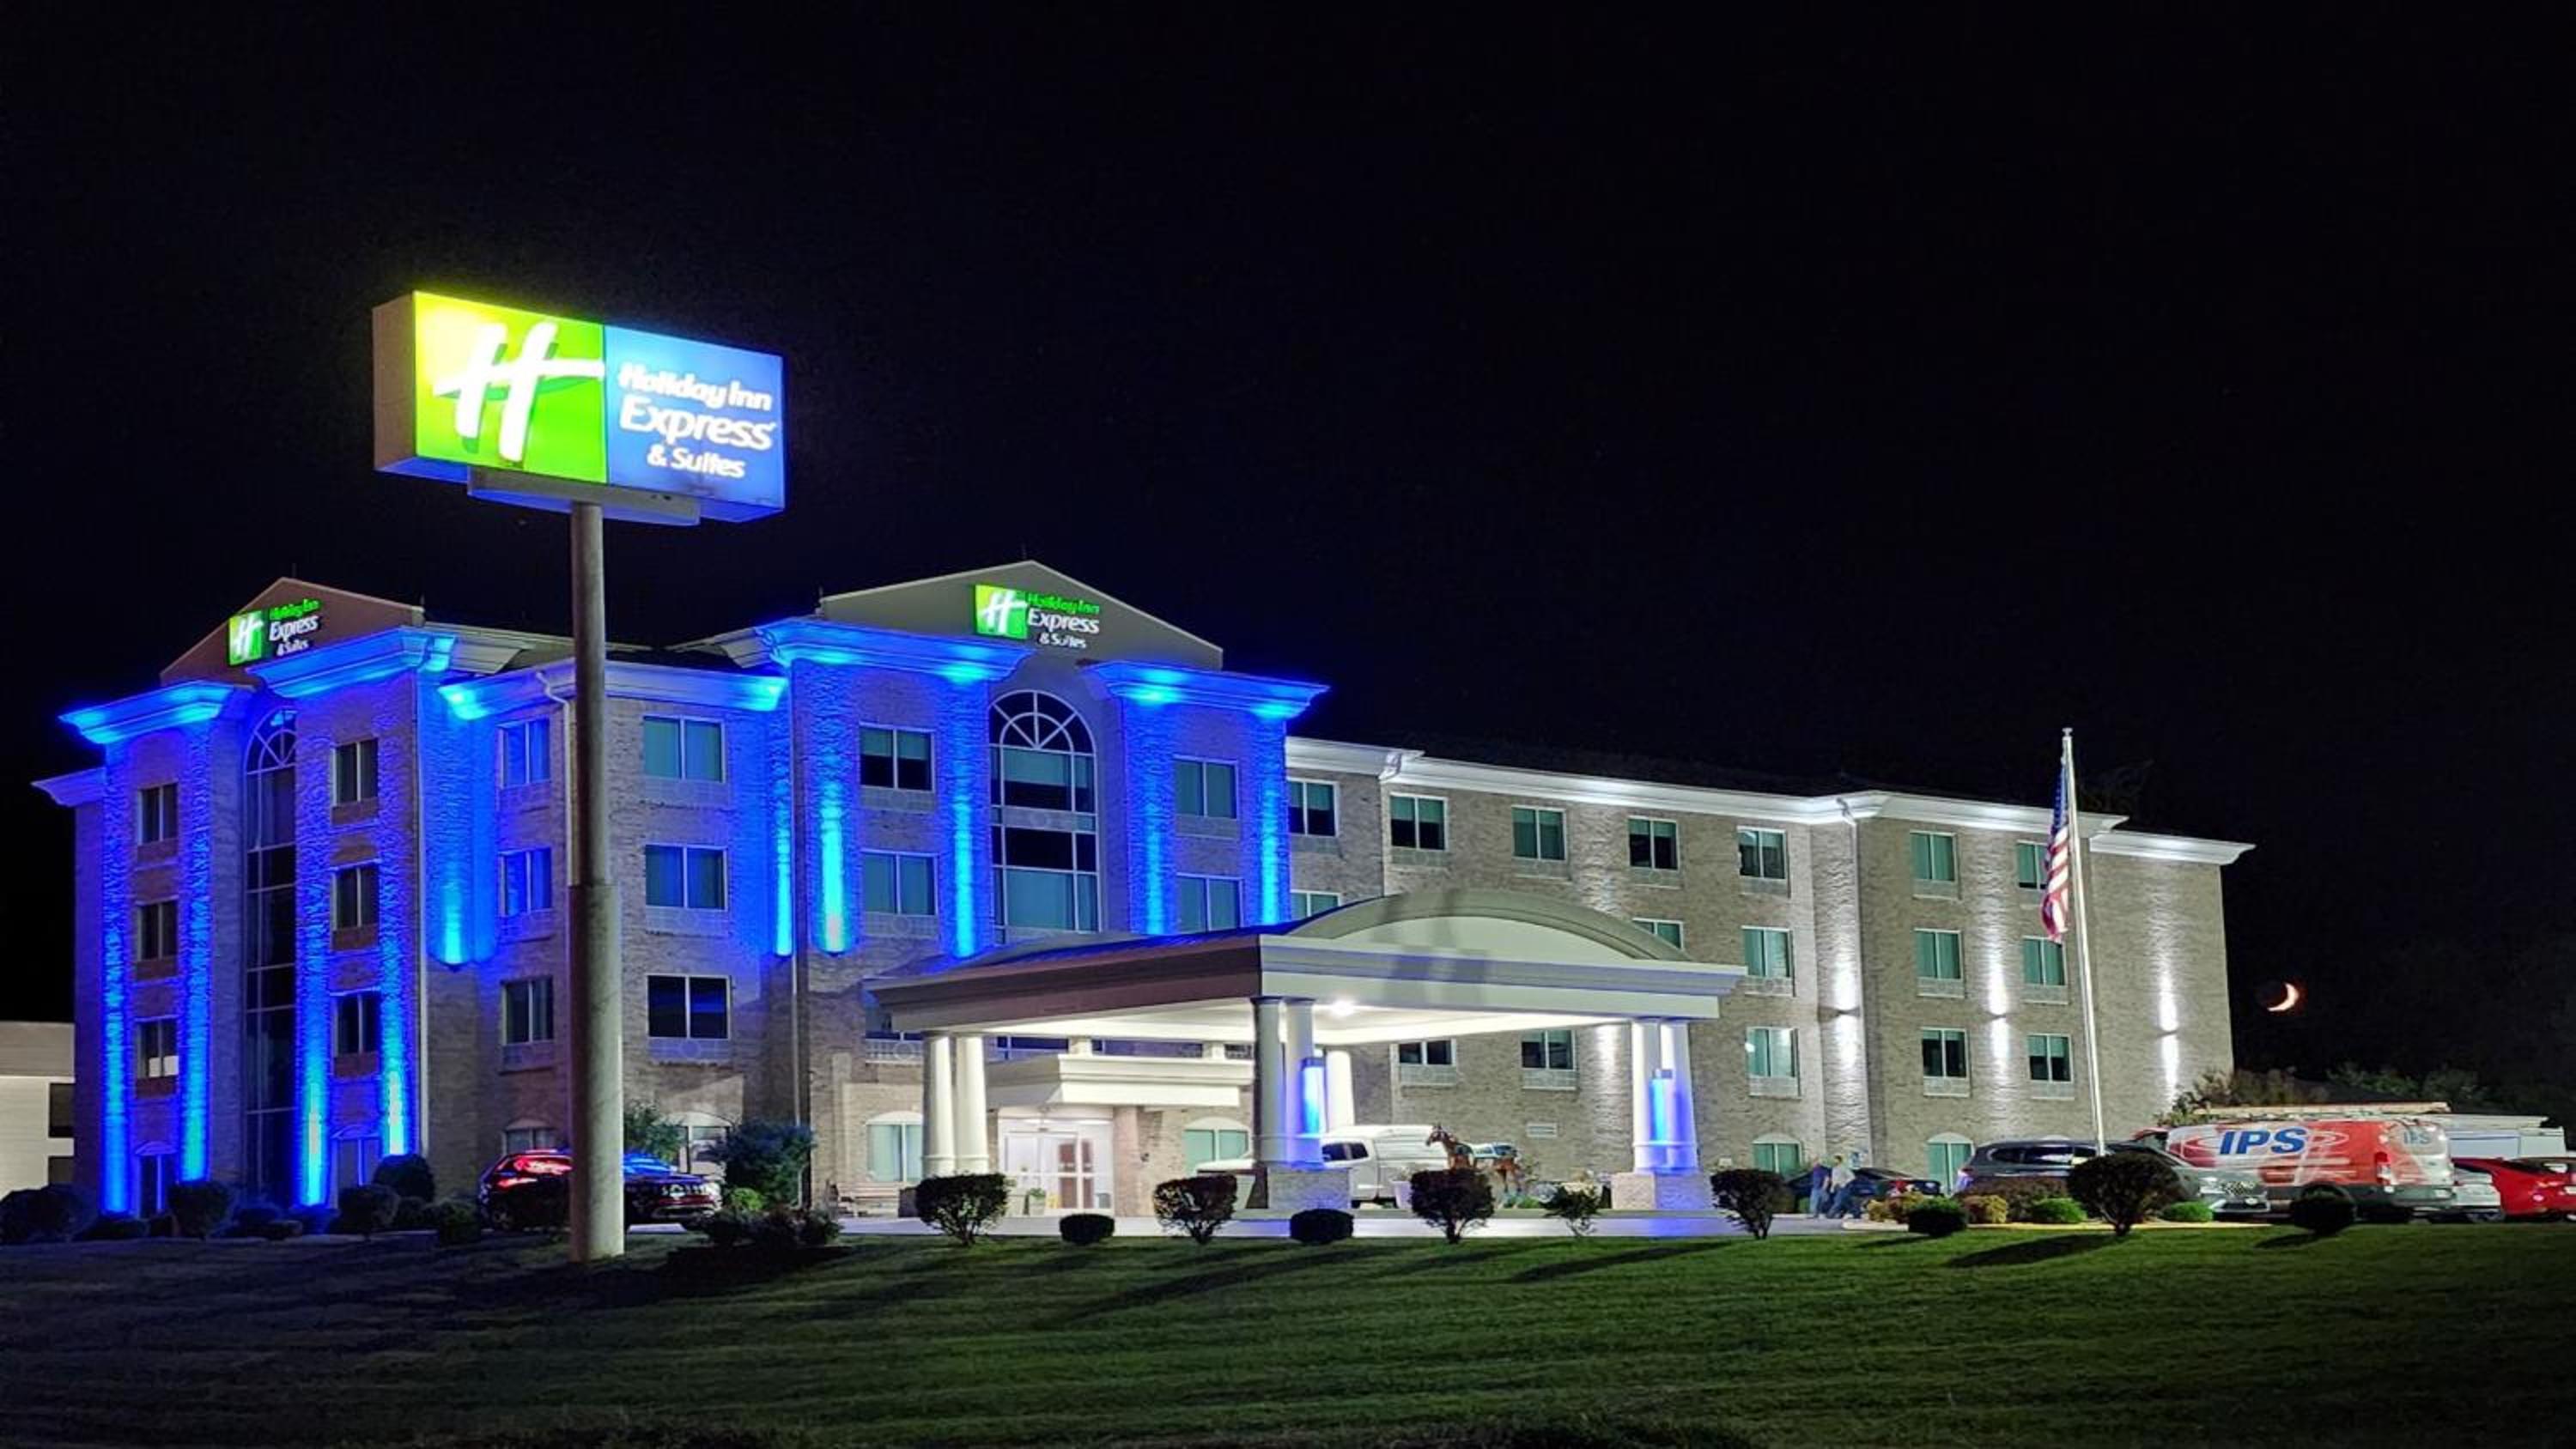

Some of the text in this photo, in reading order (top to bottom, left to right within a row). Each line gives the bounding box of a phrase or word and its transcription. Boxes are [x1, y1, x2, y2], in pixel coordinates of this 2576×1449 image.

[618, 361, 773, 411] Holiday Inn
[619, 394, 773, 451] Express
[647, 443, 746, 479] & Suites
[1028, 592, 1076, 615] Holiday
[269, 615, 319, 641] Express
[1027, 608, 1100, 634] Express
[1050, 633, 1087, 649] Suites
[2220, 1126, 2307, 1155] IPS
